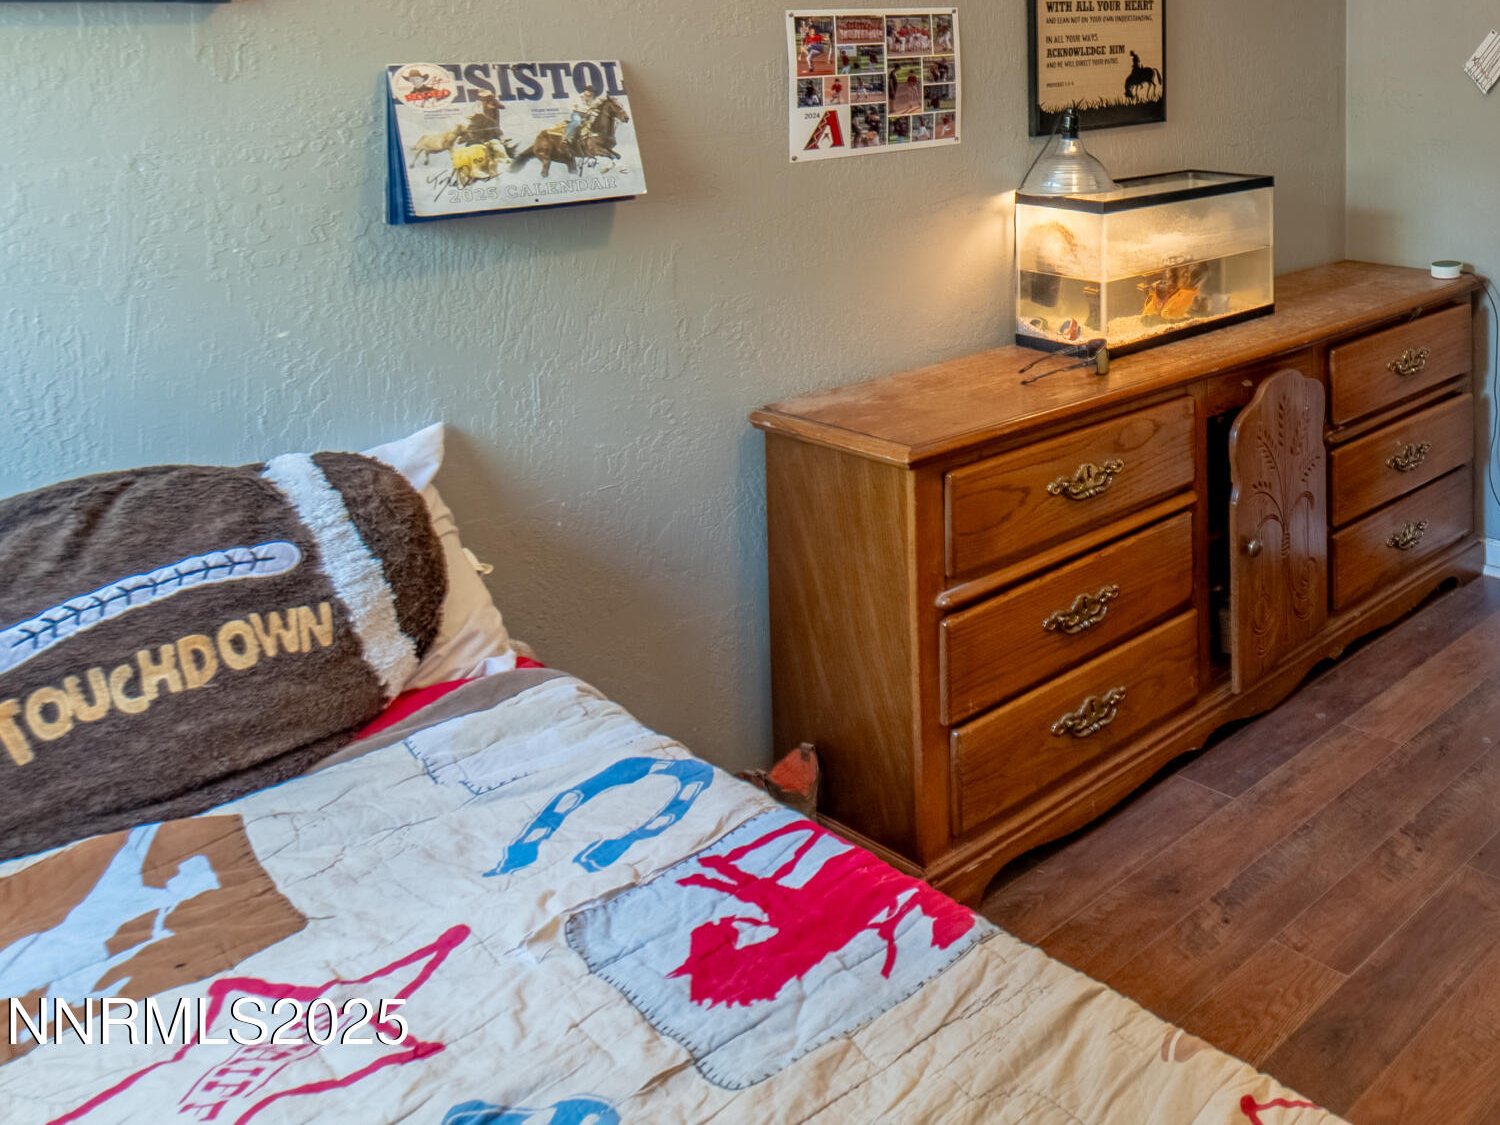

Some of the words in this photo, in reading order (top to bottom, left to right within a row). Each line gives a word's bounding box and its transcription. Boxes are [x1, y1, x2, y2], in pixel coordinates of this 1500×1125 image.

[1046, 1, 1073, 13] WITH
[1076, 0, 1095, 12] ALL
[1097, 0, 1121, 12] YOUR
[1124, 0, 1154, 11] HEART
[1045, 35, 1053, 44] IN
[1053, 35, 1064, 44] ALL
[1065, 34, 1081, 43] YOUR
[1046, 46, 1107, 59] ACKNOWLEDGE
[1109, 44, 1125, 55] HIM
[387, 61, 628, 105] ESISTOL
[804, 111, 820, 120] 2024
[449, 187, 498, 204] 2025
[504, 176, 618, 199] CALENDAR
[0, 602, 335, 767] TOUCHDOWN
